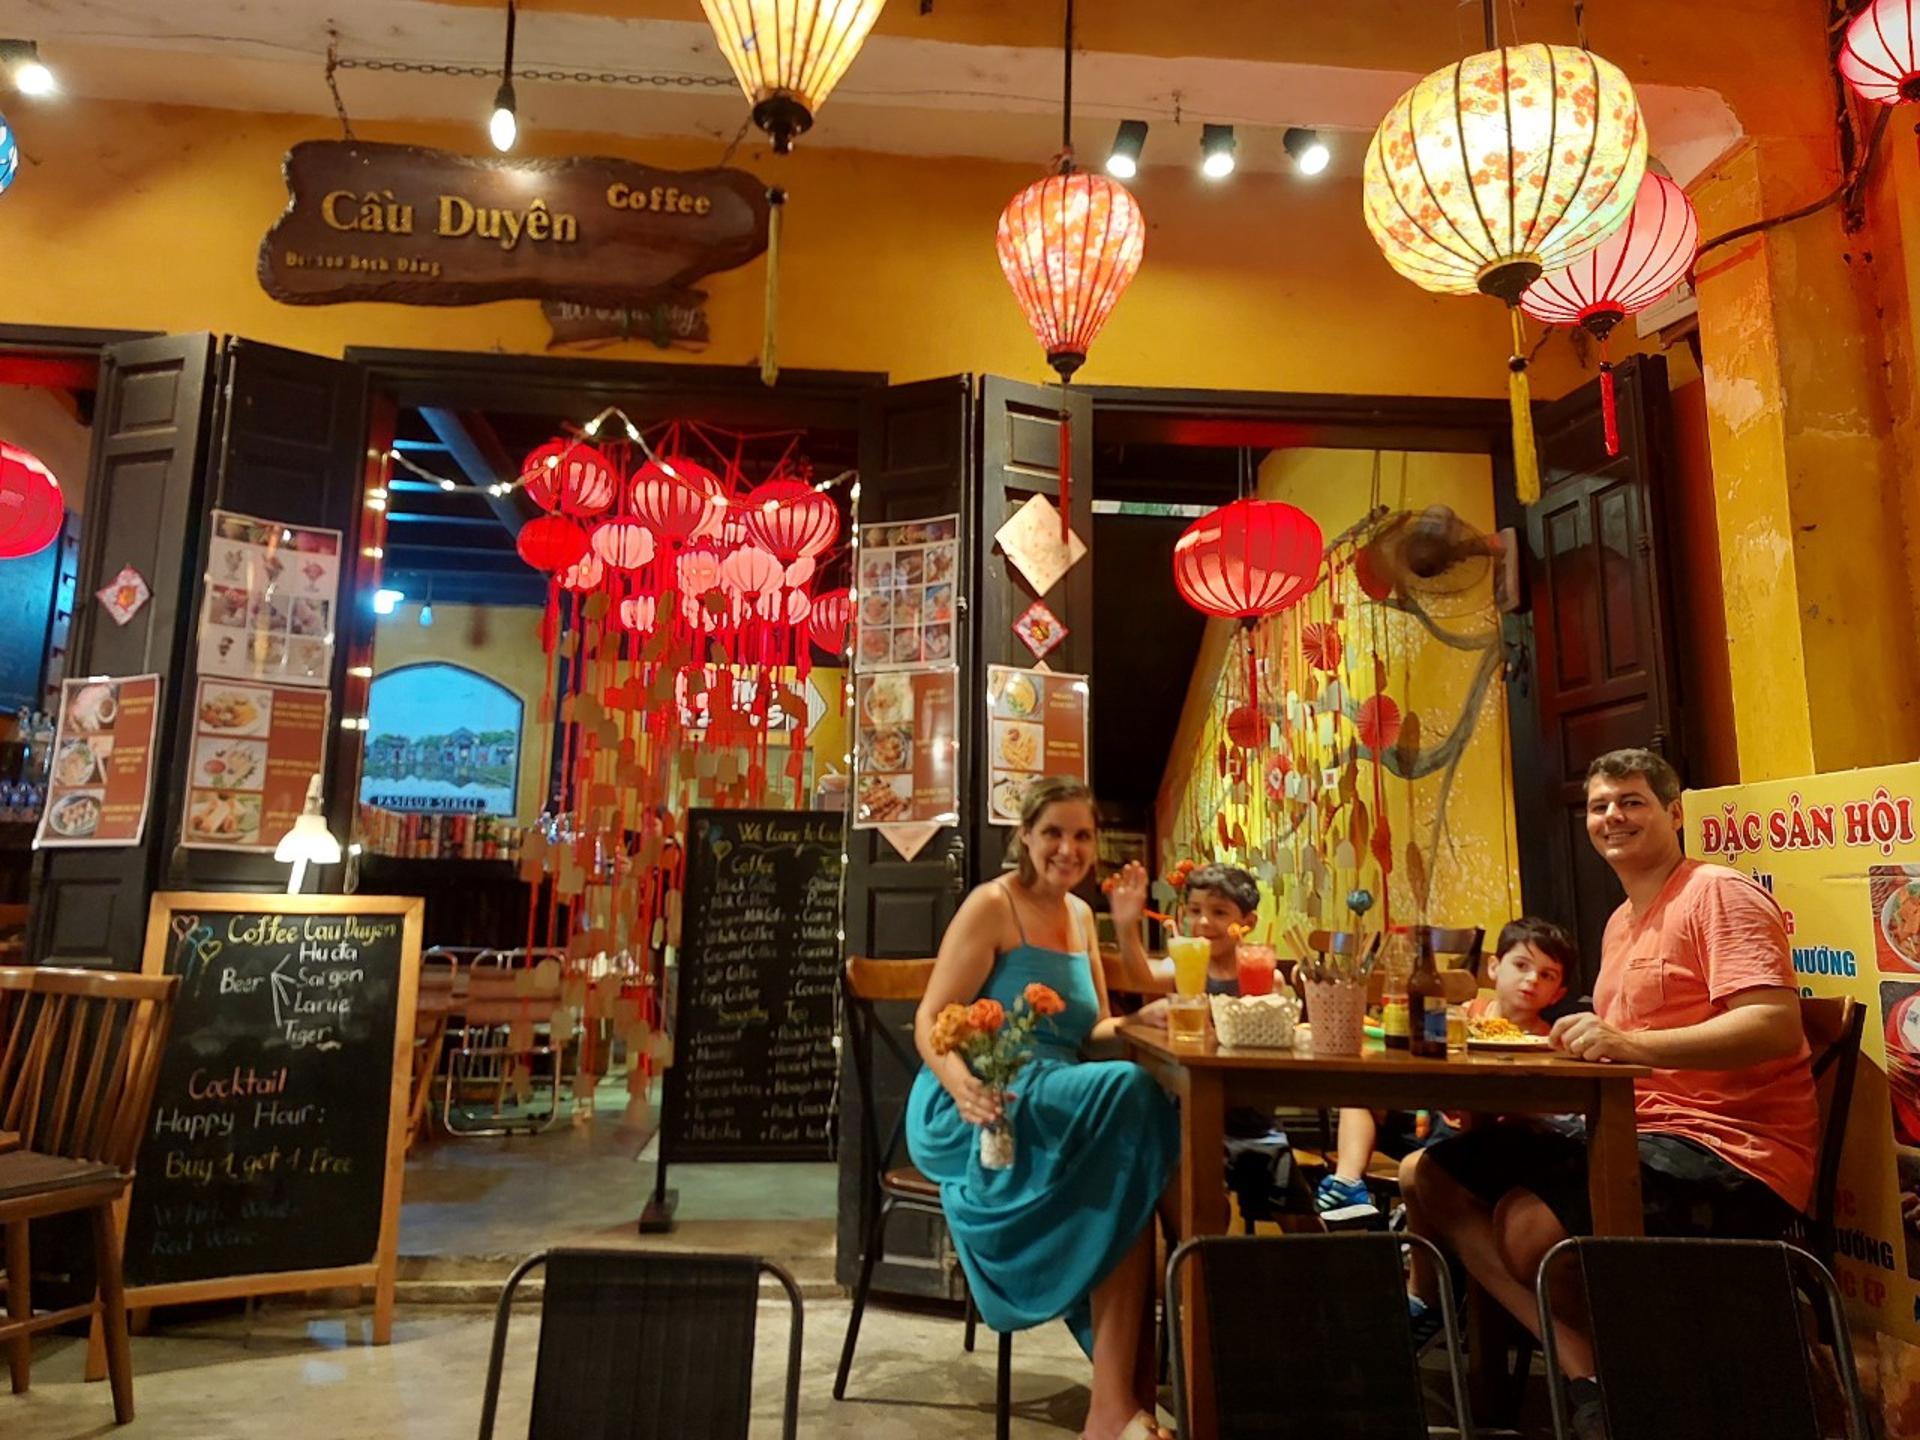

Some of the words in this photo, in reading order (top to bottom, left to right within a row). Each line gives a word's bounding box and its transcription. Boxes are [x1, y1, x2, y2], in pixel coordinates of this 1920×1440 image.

[606, 182, 711, 215] Coffee
[321, 190, 414, 235] Cầu
[438, 195, 578, 250] Duyên
[1701, 802, 1763, 864] ĐẶC
[1768, 790, 1836, 852] SẢN
[1843, 785, 1915, 856] HỘI
[227, 915, 298, 945] Coffee
[303, 915, 338, 940] Cau
[299, 941, 358, 963] Huda
[1793, 945, 1857, 978] NƯỚNG
[220, 967, 265, 994] Beer
[298, 965, 363, 992] Saigon
[294, 991, 350, 1014] Larue
[282, 1018, 333, 1049] Tiger
[188, 1066, 287, 1100] Cocktail
[155, 1107, 235, 1140] Happy
[254, 1102, 326, 1129] Hour:
[166, 1151, 213, 1186] Buy
